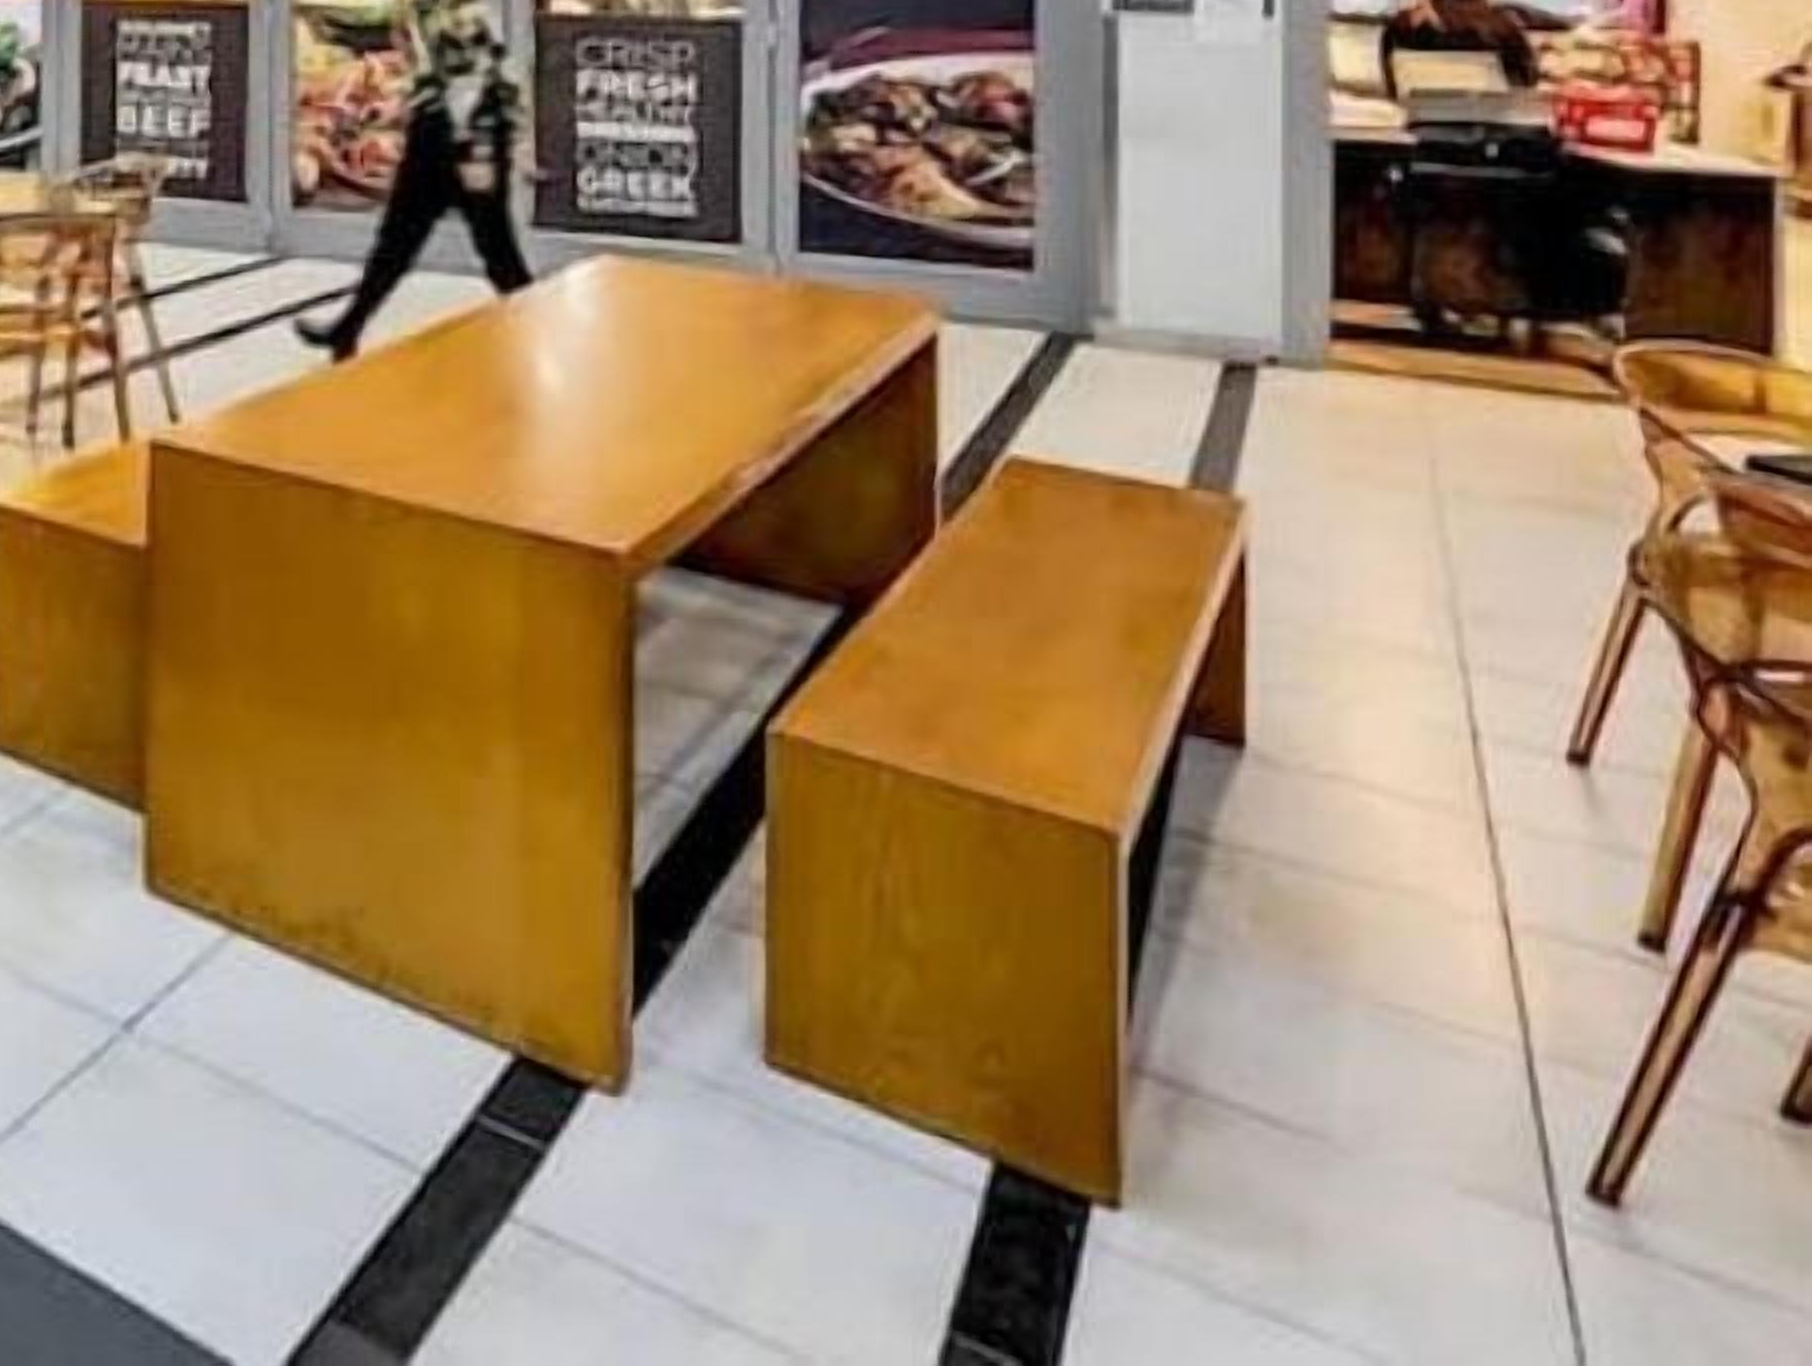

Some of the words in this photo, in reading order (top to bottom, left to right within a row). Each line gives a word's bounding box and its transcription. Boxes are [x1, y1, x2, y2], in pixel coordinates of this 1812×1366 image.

[575, 68, 698, 103] FRESH
[118, 105, 213, 140] BEEF
[575, 165, 696, 201] GREEK
